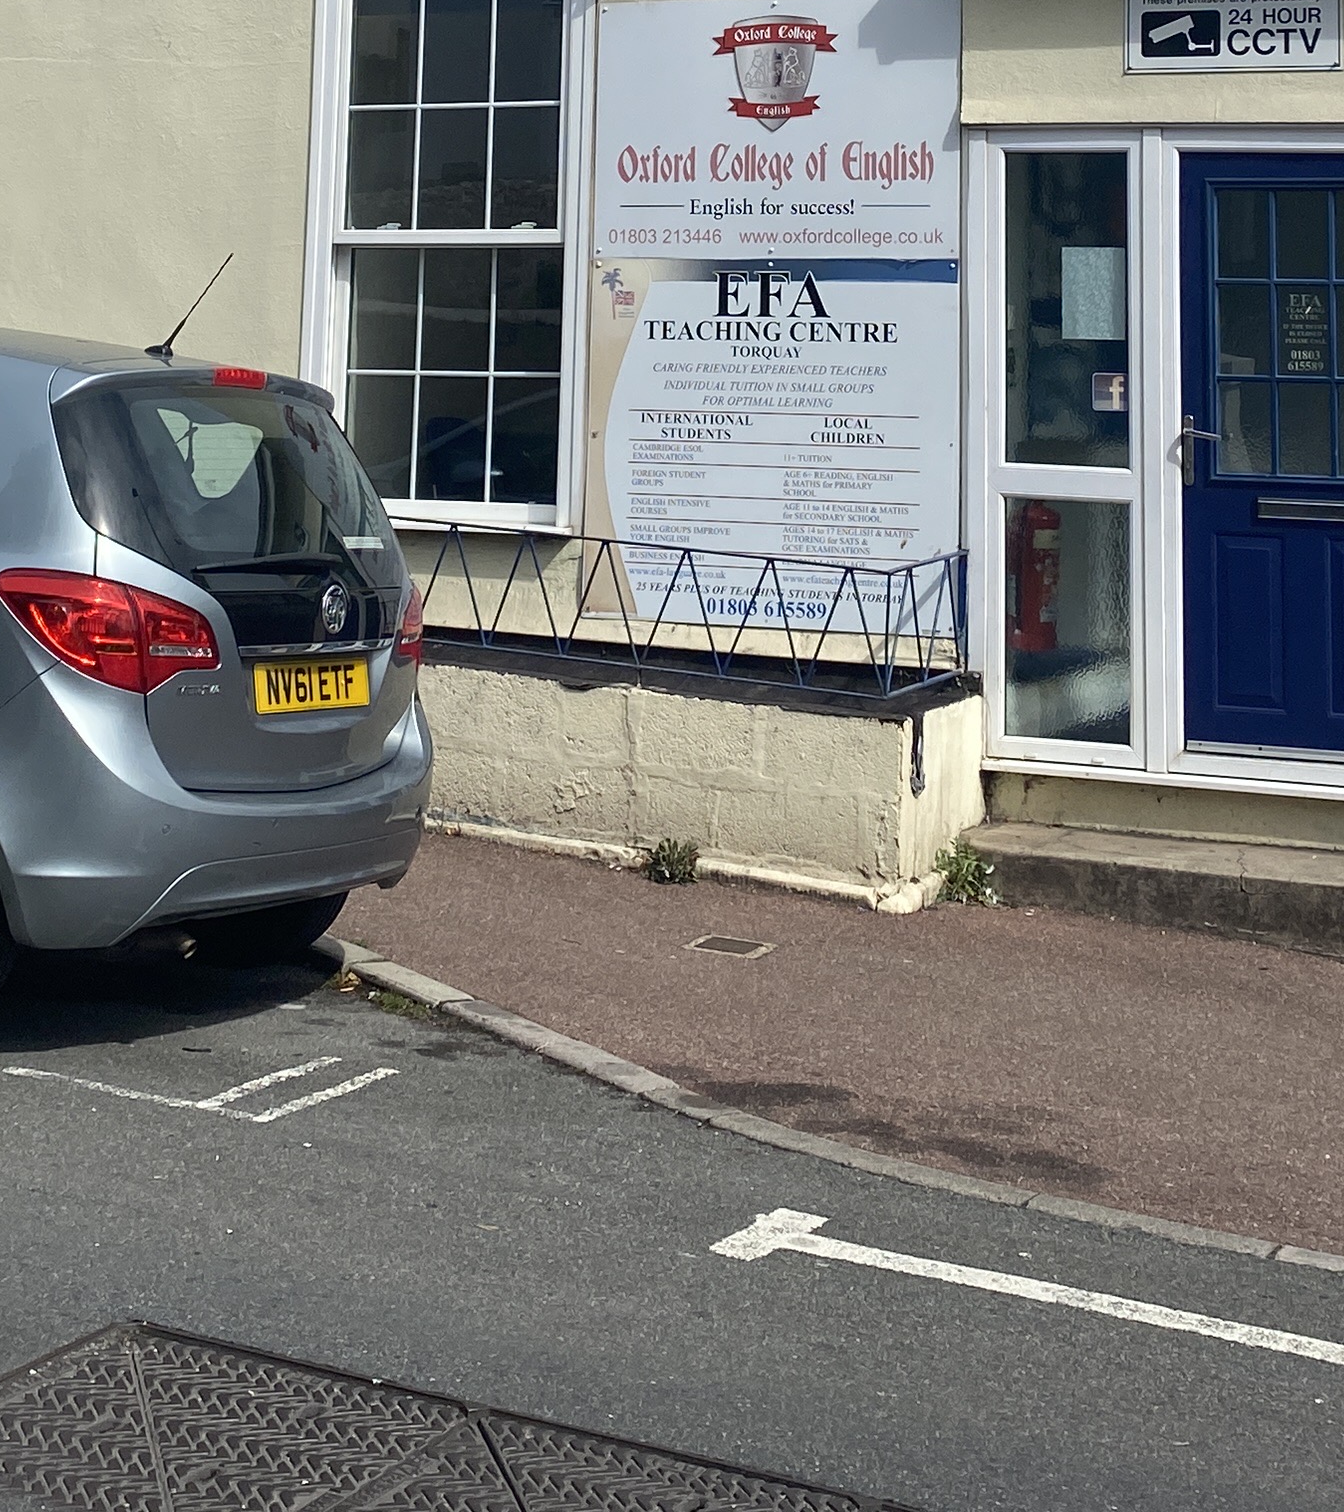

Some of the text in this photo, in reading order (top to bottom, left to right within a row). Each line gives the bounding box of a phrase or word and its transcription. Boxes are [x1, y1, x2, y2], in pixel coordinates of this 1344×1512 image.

[1228, 8, 1322, 25] 24 HOUR
[734, 25, 817, 42] Oxford College
[1227, 28, 1322, 56] CCTV
[756, 105, 791, 117] English
[617, 140, 934, 191] Oxford College of English
[690, 197, 855, 220] English for success!
[608, 228, 943, 248] 01803 213446 www.oxfordcollege.co.uk
[714, 270, 831, 318] EFA
[1289, 294, 1321, 307] EFA
[644, 320, 898, 343] TEACHING CENTRE
[730, 346, 803, 359] TORQUAY
[1291, 350, 1321, 360] 01803
[653, 363, 887, 377] CARING FRIENDLY EXPERIENCED TEACHERS
[1288, 362, 1324, 371] 615589
[664, 380, 875, 394] INDIVIDUAL TUITION IN SMALL GROUPS
[702, 396, 833, 408] FOR OPTIMAL LEARNING
[640, 412, 753, 426] INTERNATIONAL
[824, 417, 873, 429] LOCAL
[661, 428, 731, 440] STUDENTS
[810, 432, 885, 445] CHILDREN
[632, 443, 704, 453] CAMBRIDGE ESOL
[632, 452, 694, 461] EXAMINATIONS
[798, 454, 832, 463] TUITION
[632, 470, 706, 479] FOREIGN STUDENT
[784, 471, 801, 479] AGE
[857, 473, 894, 481] ENGLISH
[631, 478, 664, 487] GROUPS
[792, 480, 820, 488] MATHS
[783, 489, 816, 497] SCHOOL
[631, 498, 711, 508] ENGLISH INTENSIVE
[784, 503, 800, 511] AGE
[832, 504, 869, 513] ENGLISH
[880, 507, 909, 515] MATHS
[631, 507, 667, 515] COURSES
[795, 512, 845, 521] SECONDARY
[848, 514, 882, 522] SCHOOL
[630, 524, 731, 536] SMALL GROUPS IMPROVE
[837, 528, 873, 536] ENGLISH
[884, 530, 914, 538] MATHS
[630, 533, 690, 543] YOUR ENGLISH
[782, 535, 825, 543] TUTORING
[828, 536, 838, 544] for
[782, 544, 870, 555] GCSE EXAMINATIONS
[629, 551, 705, 562] BUSINESS ENSH
[629, 568, 726, 579] www.efa-laguae.co.uk
[636, 582, 646, 590] 25
[712, 586, 728, 595] OF
[707, 598, 827, 619] 01803 615589
[266, 664, 355, 705] NV61 ETF
